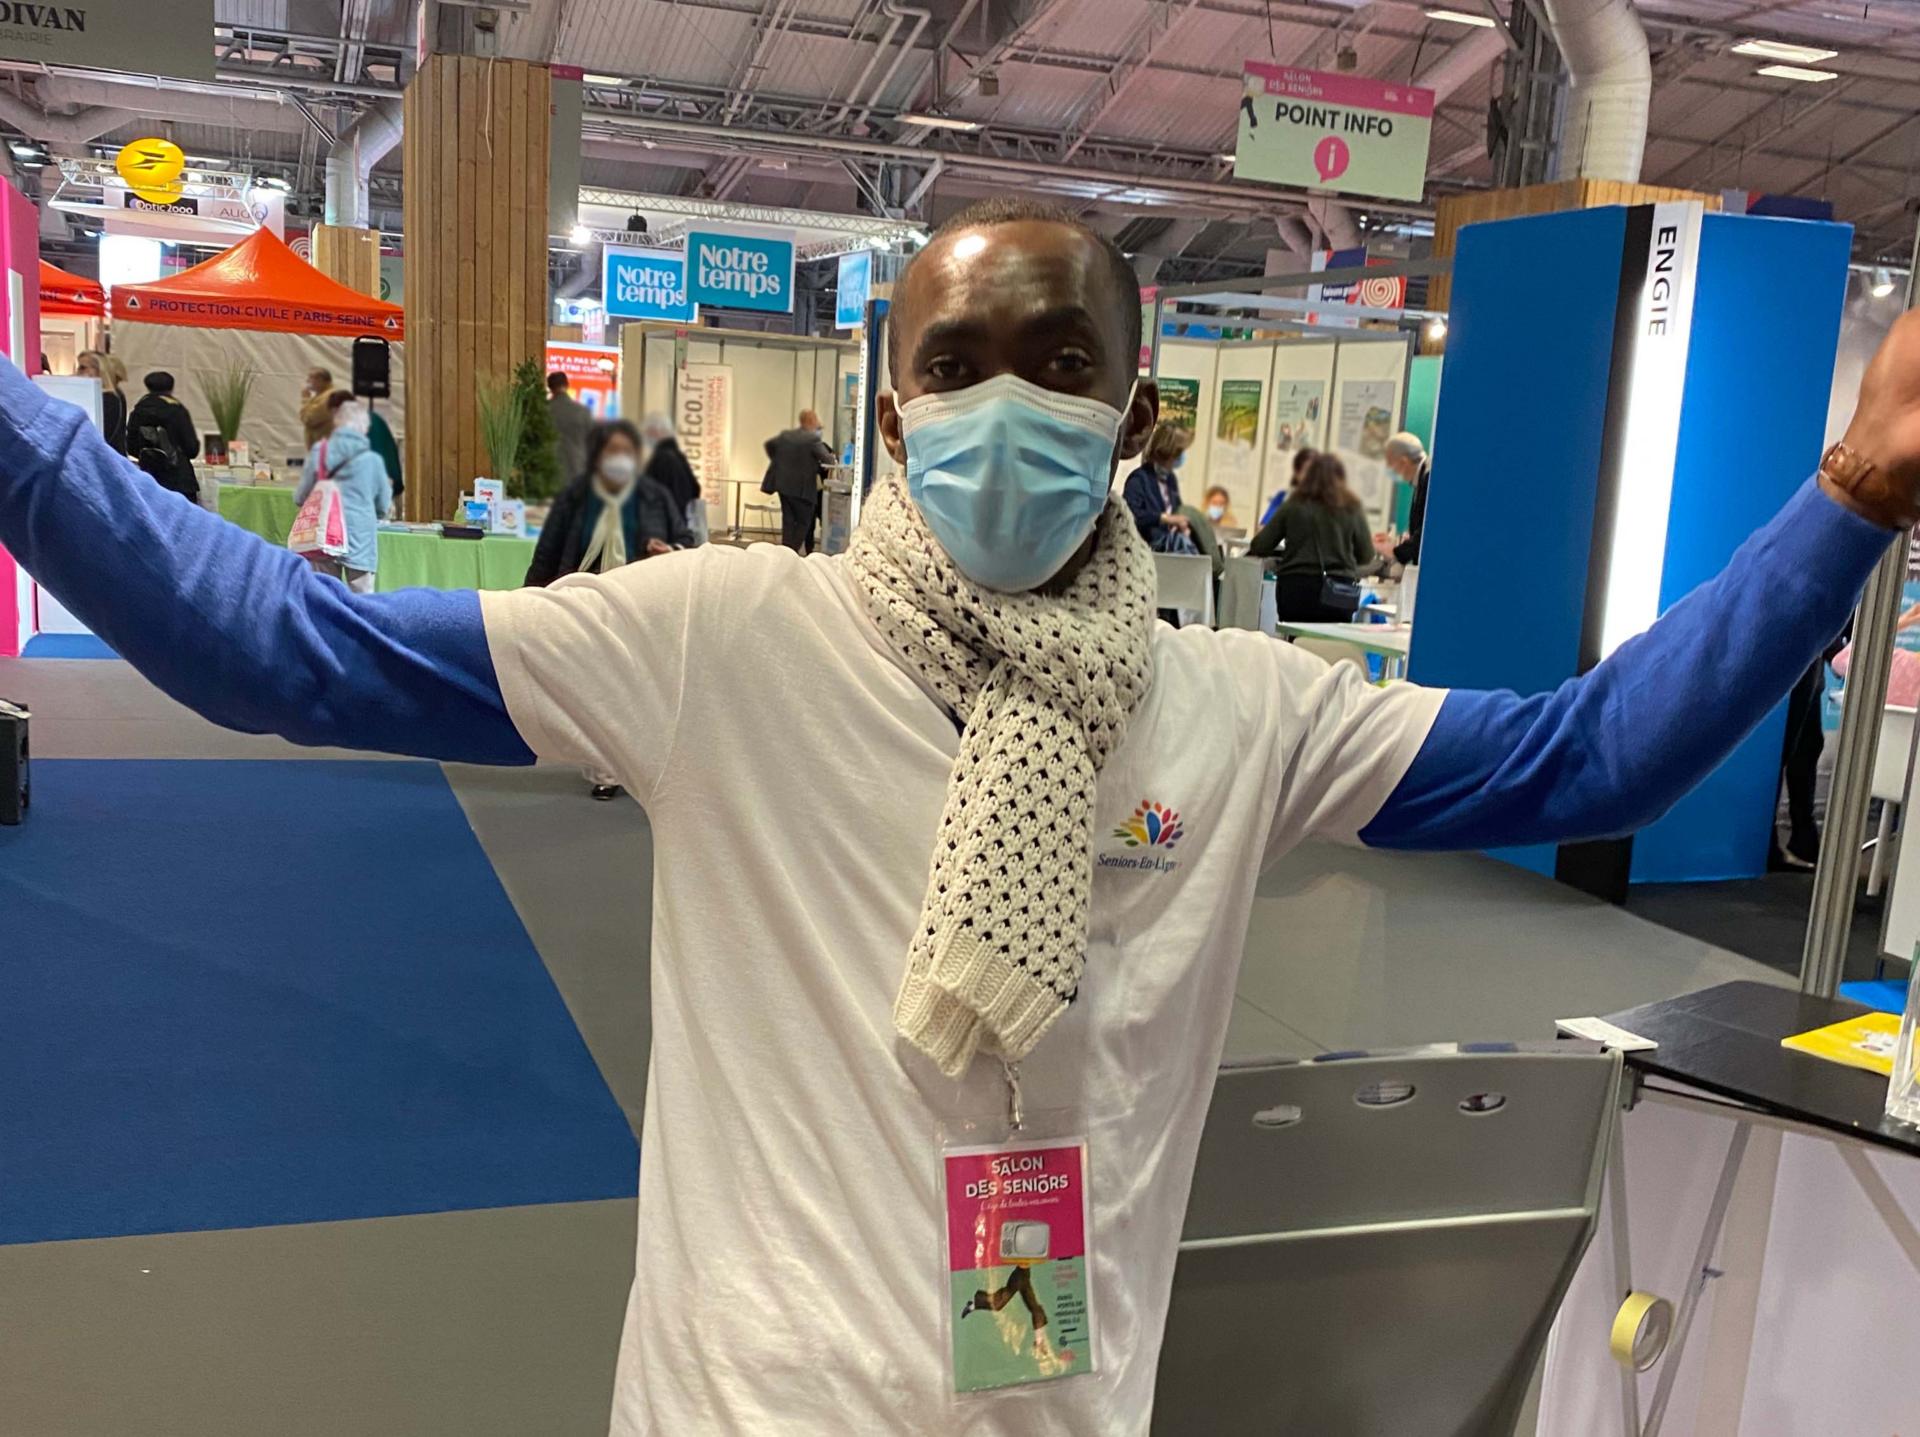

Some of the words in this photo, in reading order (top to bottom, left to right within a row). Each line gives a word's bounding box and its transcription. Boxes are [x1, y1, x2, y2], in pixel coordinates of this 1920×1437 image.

[1275, 101, 1341, 130] POINT
[1343, 112, 1393, 137] INFO
[135, 200, 166, 213] Optic
[167, 203, 194, 215] 2000
[700, 243, 768, 273] Notre
[617, 264, 676, 288] Notre
[698, 268, 781, 299] temps
[1648, 226, 1678, 336] ENGIE
[616, 282, 687, 310] temps
[149, 299, 241, 316] PROTECTION
[244, 305, 289, 320] CIVILE
[293, 310, 333, 324] PARIS
[337, 315, 376, 327] SEINE
[991, 1156, 1043, 1176] SALON
[965, 1179, 998, 1198] DES
[1003, 1174, 1069, 1194] SENIORS
